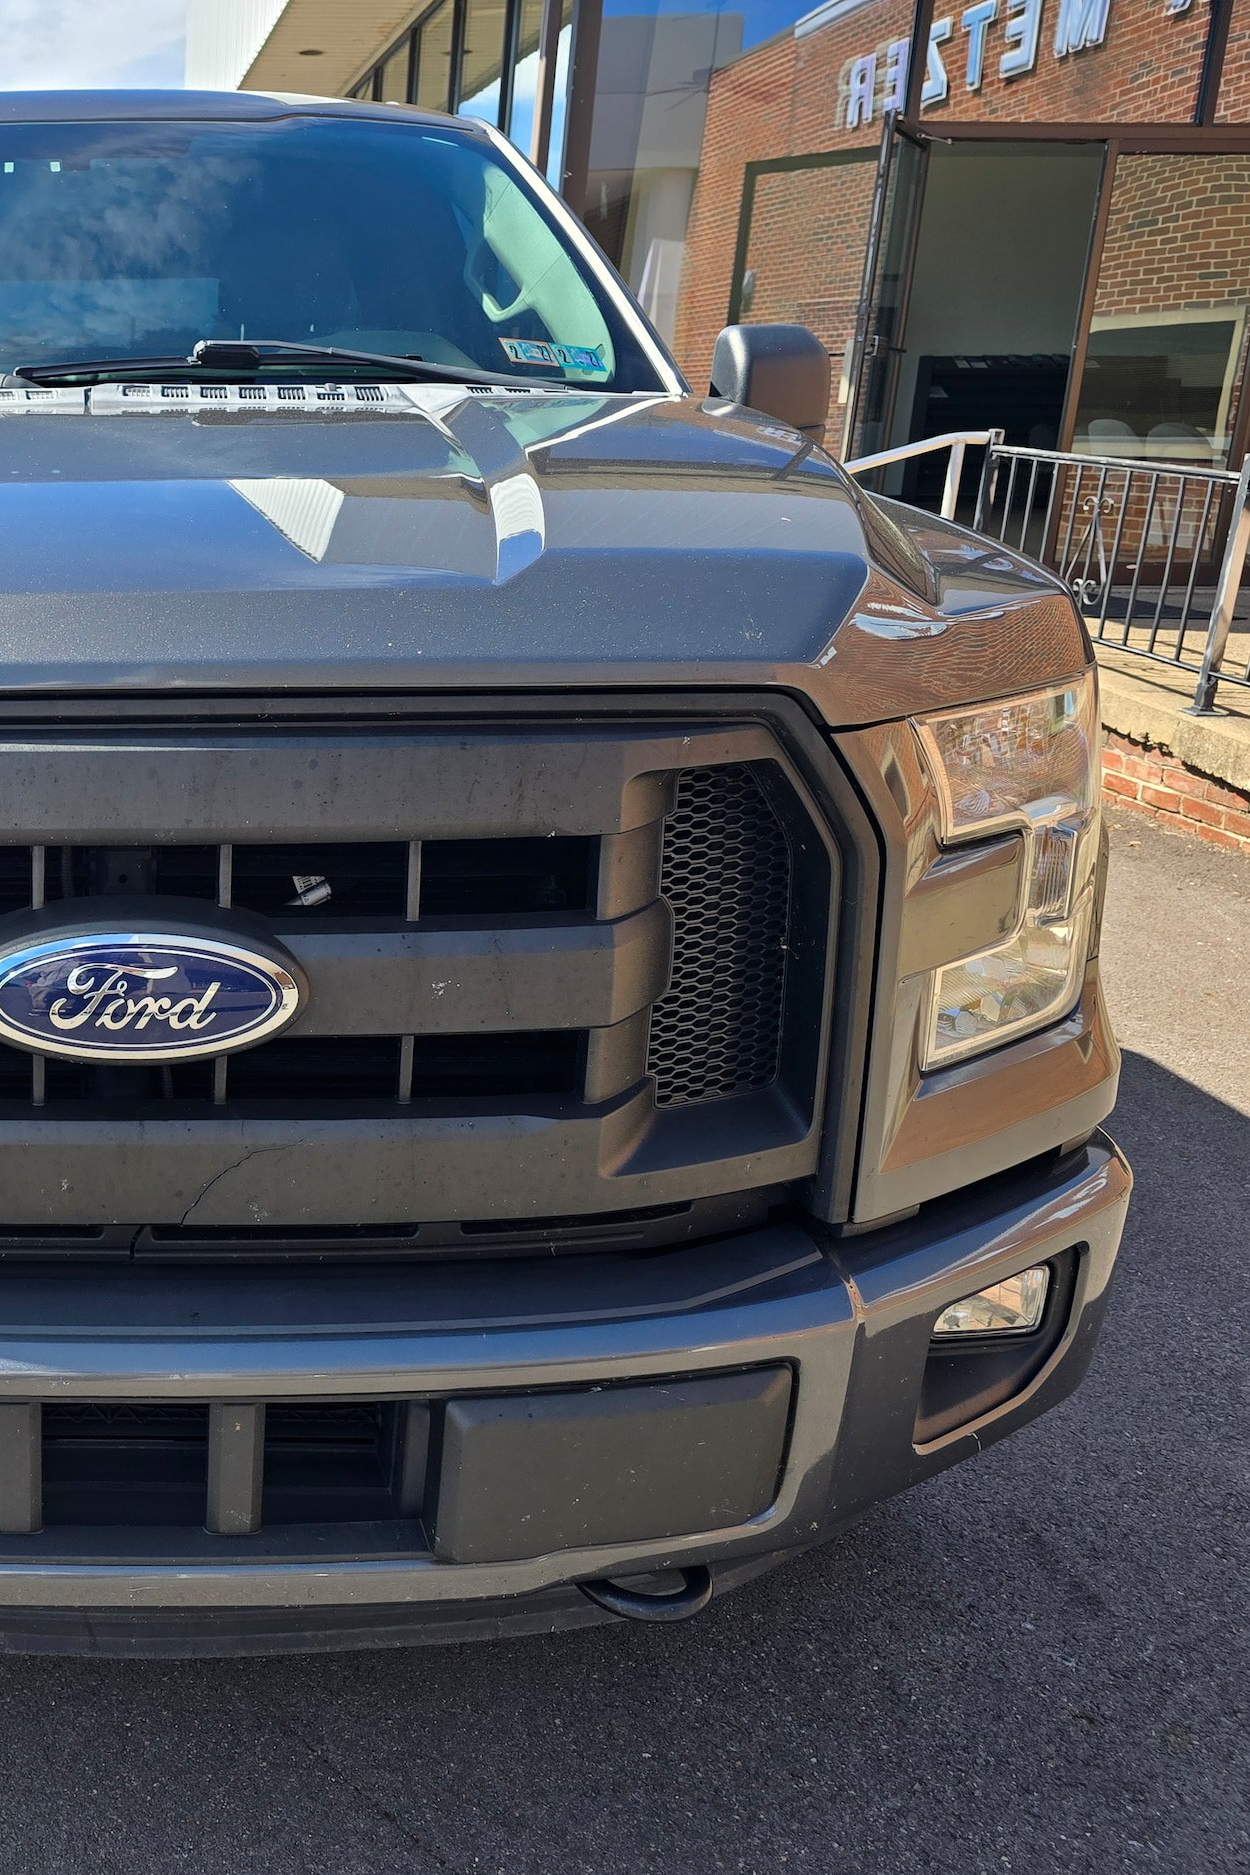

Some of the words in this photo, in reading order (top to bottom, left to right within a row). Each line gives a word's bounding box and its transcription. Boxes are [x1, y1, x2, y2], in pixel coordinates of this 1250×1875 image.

[509, 345, 522, 360] 2
[557, 349, 571, 364] 2
[49, 962, 221, 1031] Ford
